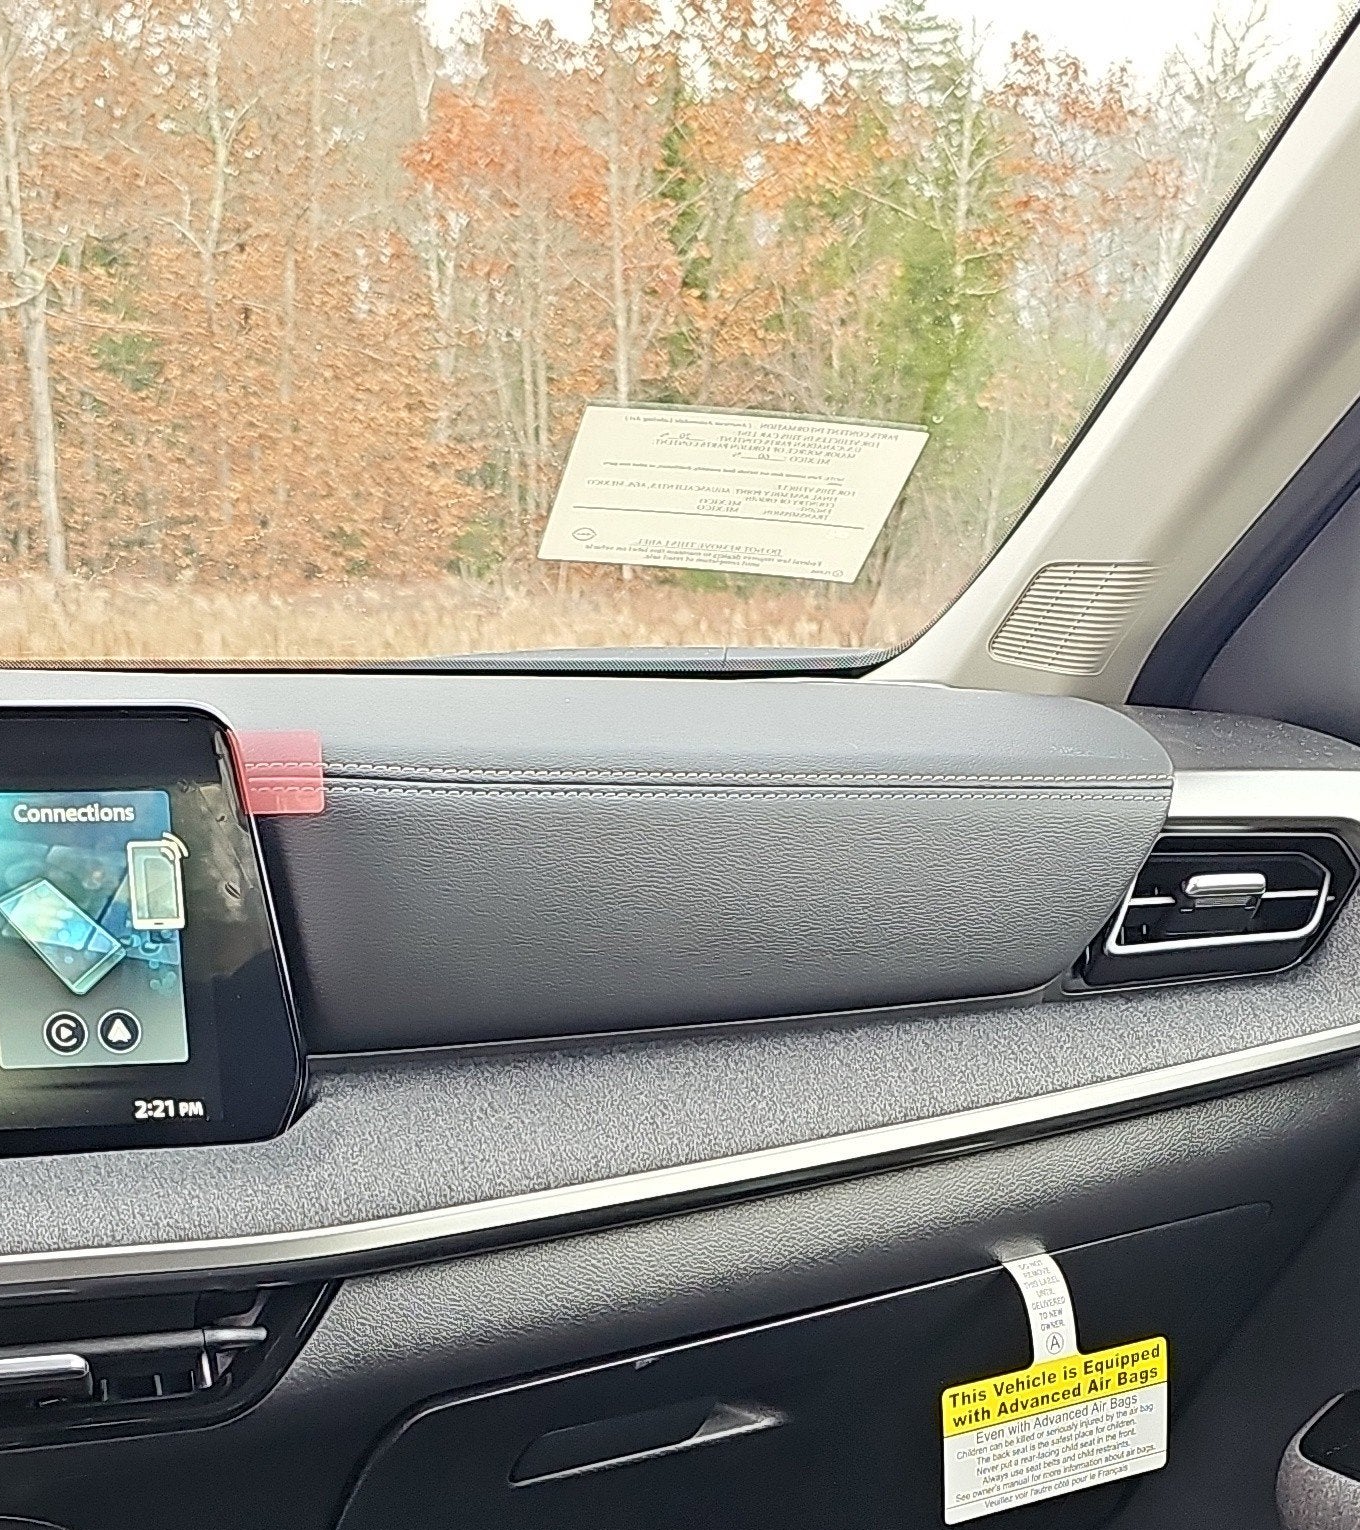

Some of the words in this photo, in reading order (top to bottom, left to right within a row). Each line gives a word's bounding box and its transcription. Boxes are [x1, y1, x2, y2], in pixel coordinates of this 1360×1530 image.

[14, 803, 135, 823] Connections
[135, 1100, 174, 1118] 2:21
[179, 1101, 204, 1117] PM
[1039, 1311, 1048, 1320] TO
[949, 1388, 987, 1409] This
[994, 1371, 1057, 1397] Vehicle
[1063, 1365, 1078, 1380] is
[1083, 1344, 1160, 1376] Equipped
[953, 1408, 991, 1428] with
[997, 1383, 1081, 1417] Advanced
[1088, 1376, 1112, 1395] Air
[1118, 1366, 1158, 1386] Bags
[956, 1446, 988, 1460] Children
[989, 1443, 1003, 1453] can
[1004, 1438, 1015, 1448] be
[1016, 1432, 1035, 1445] killed
[1036, 1430, 1045, 1440] or
[1046, 1421, 1078, 1437] seriously
[1080, 1416, 1104, 1428] injured
[1105, 1413, 1115, 1423] by
[1116, 1410, 1128, 1419] the
[1129, 1406, 1139, 1415] air
[1140, 1403, 1154, 1413] bag
[976, 1428, 1005, 1445] Even
[1008, 1420, 1031, 1436] with
[1033, 1404, 1089, 1430] Advanced
[1091, 1400, 1107, 1415] Air
[1110, 1394, 1138, 1410] Bags
[976, 1456, 991, 1466] The
[993, 1448, 1010, 1461] back
[1012, 1445, 1028, 1456] seat
[1029, 1443, 1036, 1452] is
[1037, 1439, 1050, 1449] the
[1051, 1433, 1073, 1446] safest
[1074, 1428, 1094, 1441] place
[1095, 1425, 1105, 1435] for
[1106, 1418, 1137, 1432] children.
[956, 1493, 971, 1503] See
[972, 1484, 1001, 1499] owner's
[1002, 1476, 1030, 1490] manual
[1031, 1473, 1042, 1482] for
[1042, 1467, 1062, 1479] more
[1063, 1457, 1103, 1474] information
[1104, 1450, 1125, 1463] about
[1126, 1447, 1136, 1457] air
[976, 1464, 1000, 1477] Never
[1000, 1460, 1013, 1471] put
[1013, 1458, 1019, 1467] a
[1020, 1449, 1060, 1464] rear-facing
[1061, 1442, 1079, 1453] child
[1079, 1438, 1096, 1446] seat
[1096, 1435, 1104, 1443] in
[1105, 1432, 1117, 1441] the
[982, 1471, 1009, 1485] Always
[1010, 1468, 1024, 1477] use
[1025, 1463, 1042, 1474] seat
[1043, 1458, 1061, 1470] belts
[1062, 1452, 1076, 1464] and
[1077, 1448, 1095, 1460] child
[1015, 1490, 1029, 1500] voir
[1071, 1475, 1088, 1487] pour
[1089, 1472, 1097, 1481] le
[1097, 1464, 1129, 1479] Français
